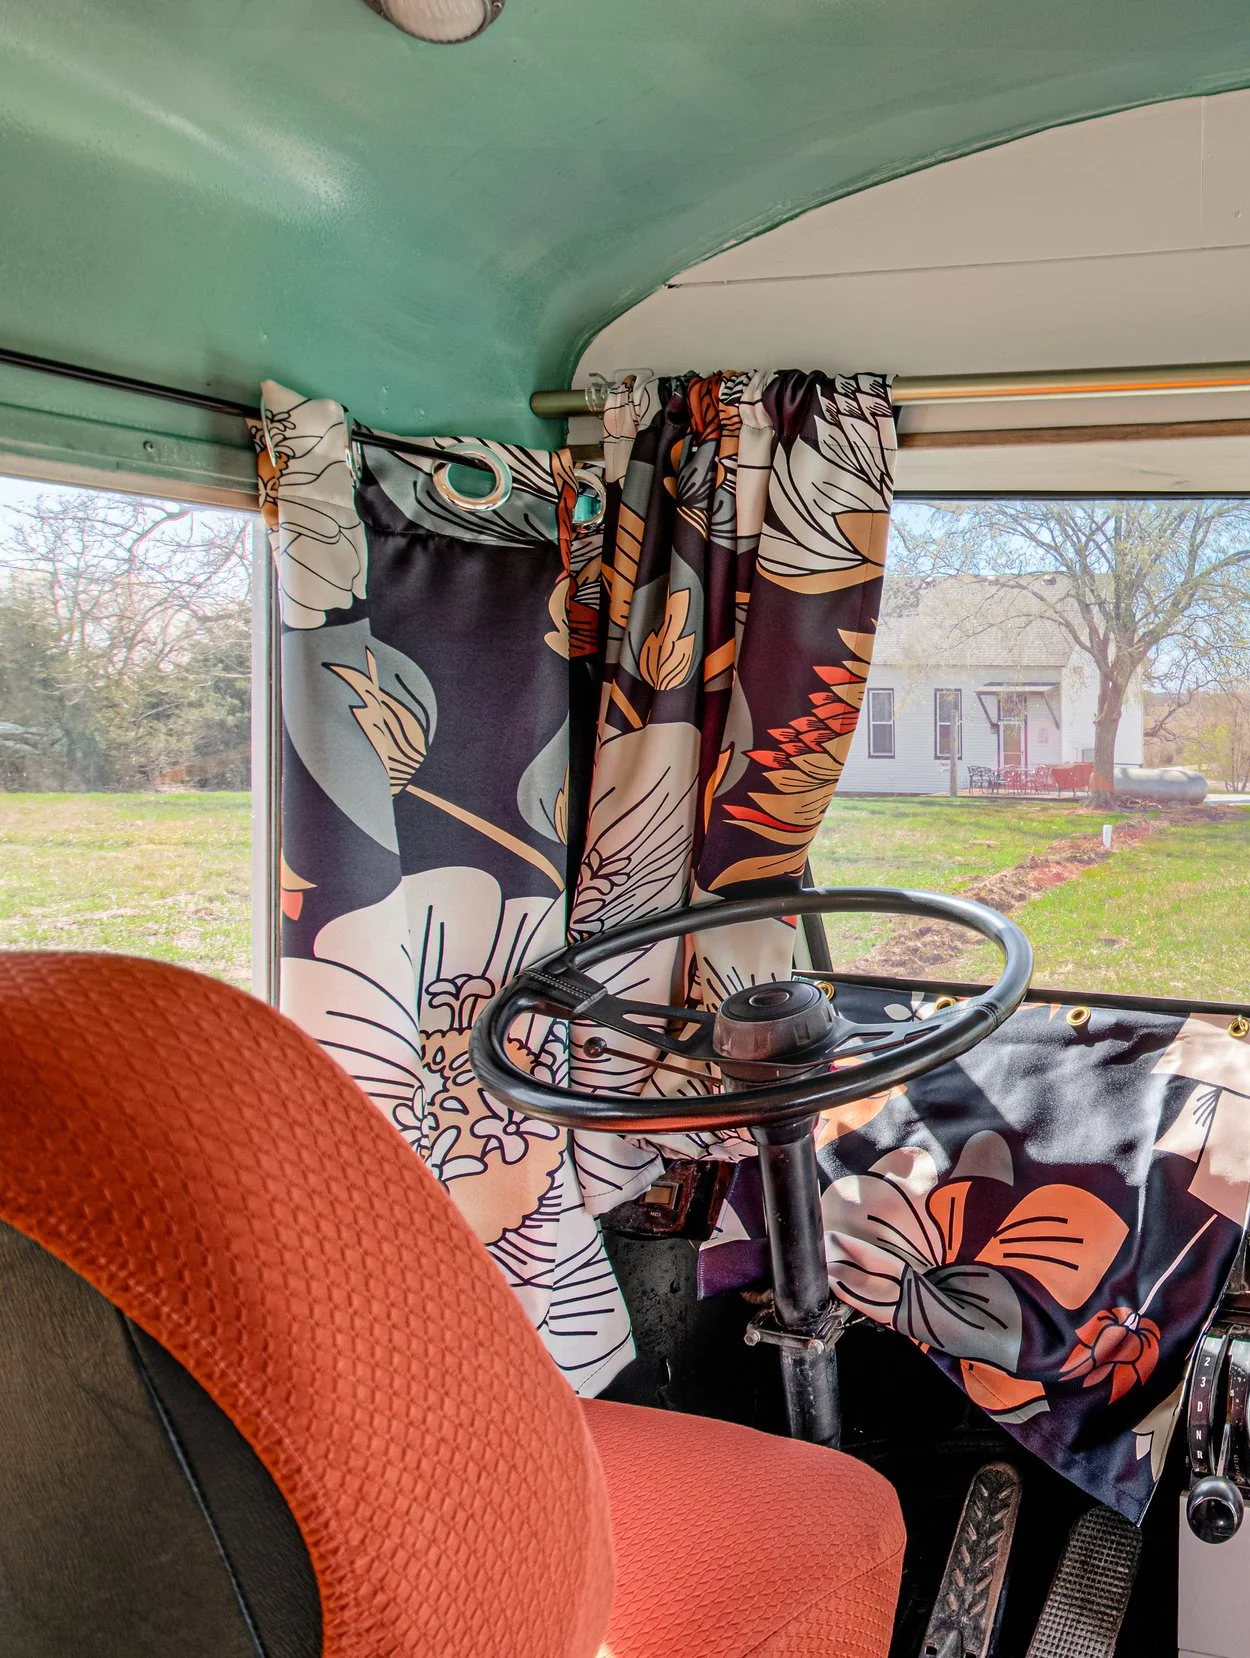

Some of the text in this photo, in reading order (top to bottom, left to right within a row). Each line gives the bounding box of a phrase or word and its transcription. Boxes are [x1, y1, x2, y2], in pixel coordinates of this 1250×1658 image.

[1203, 1357, 1211, 1367] 2
[1200, 1377, 1206, 1388] 3
[1197, 1401, 1203, 1412] D
[1196, 1430, 1202, 1440] N
[1196, 1450, 1203, 1460] R
